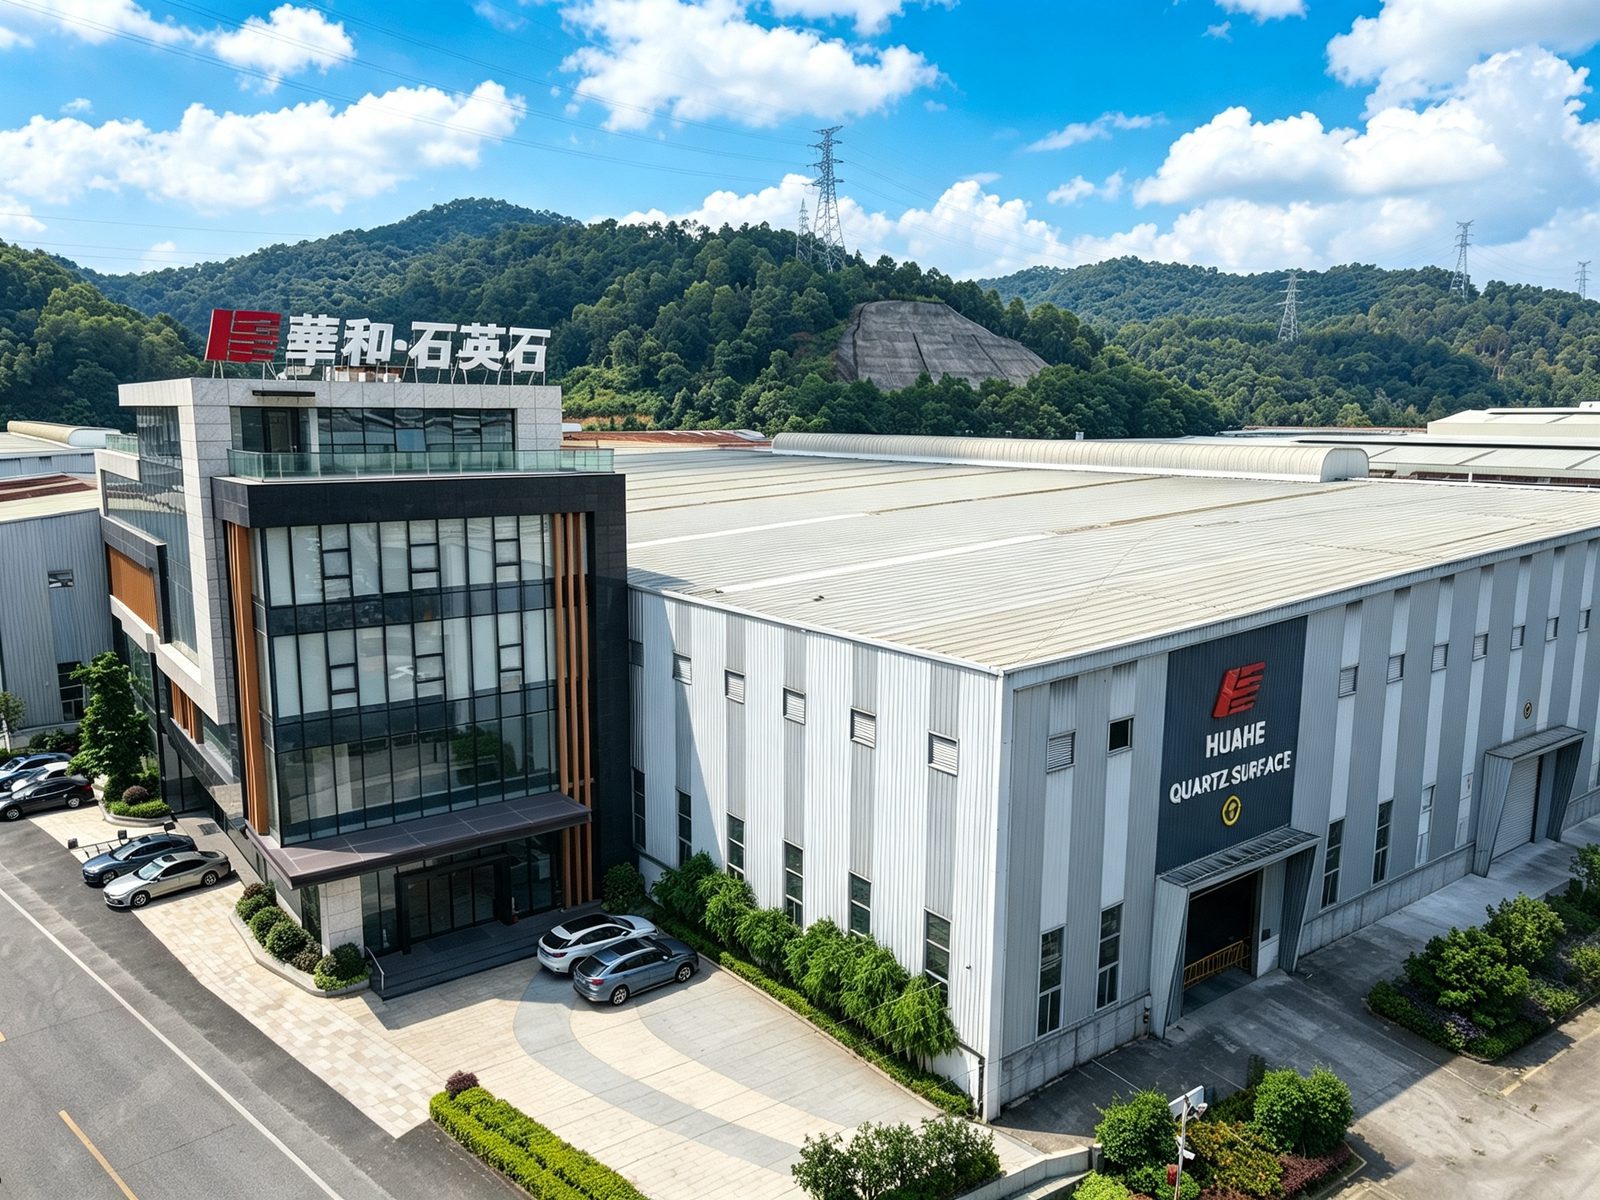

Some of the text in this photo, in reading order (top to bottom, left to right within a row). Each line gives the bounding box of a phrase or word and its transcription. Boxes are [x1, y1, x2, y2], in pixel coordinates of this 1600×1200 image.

[1205, 720, 1266, 758] HUAHE
[1169, 750, 1292, 804] QUARTZ SURFACE
